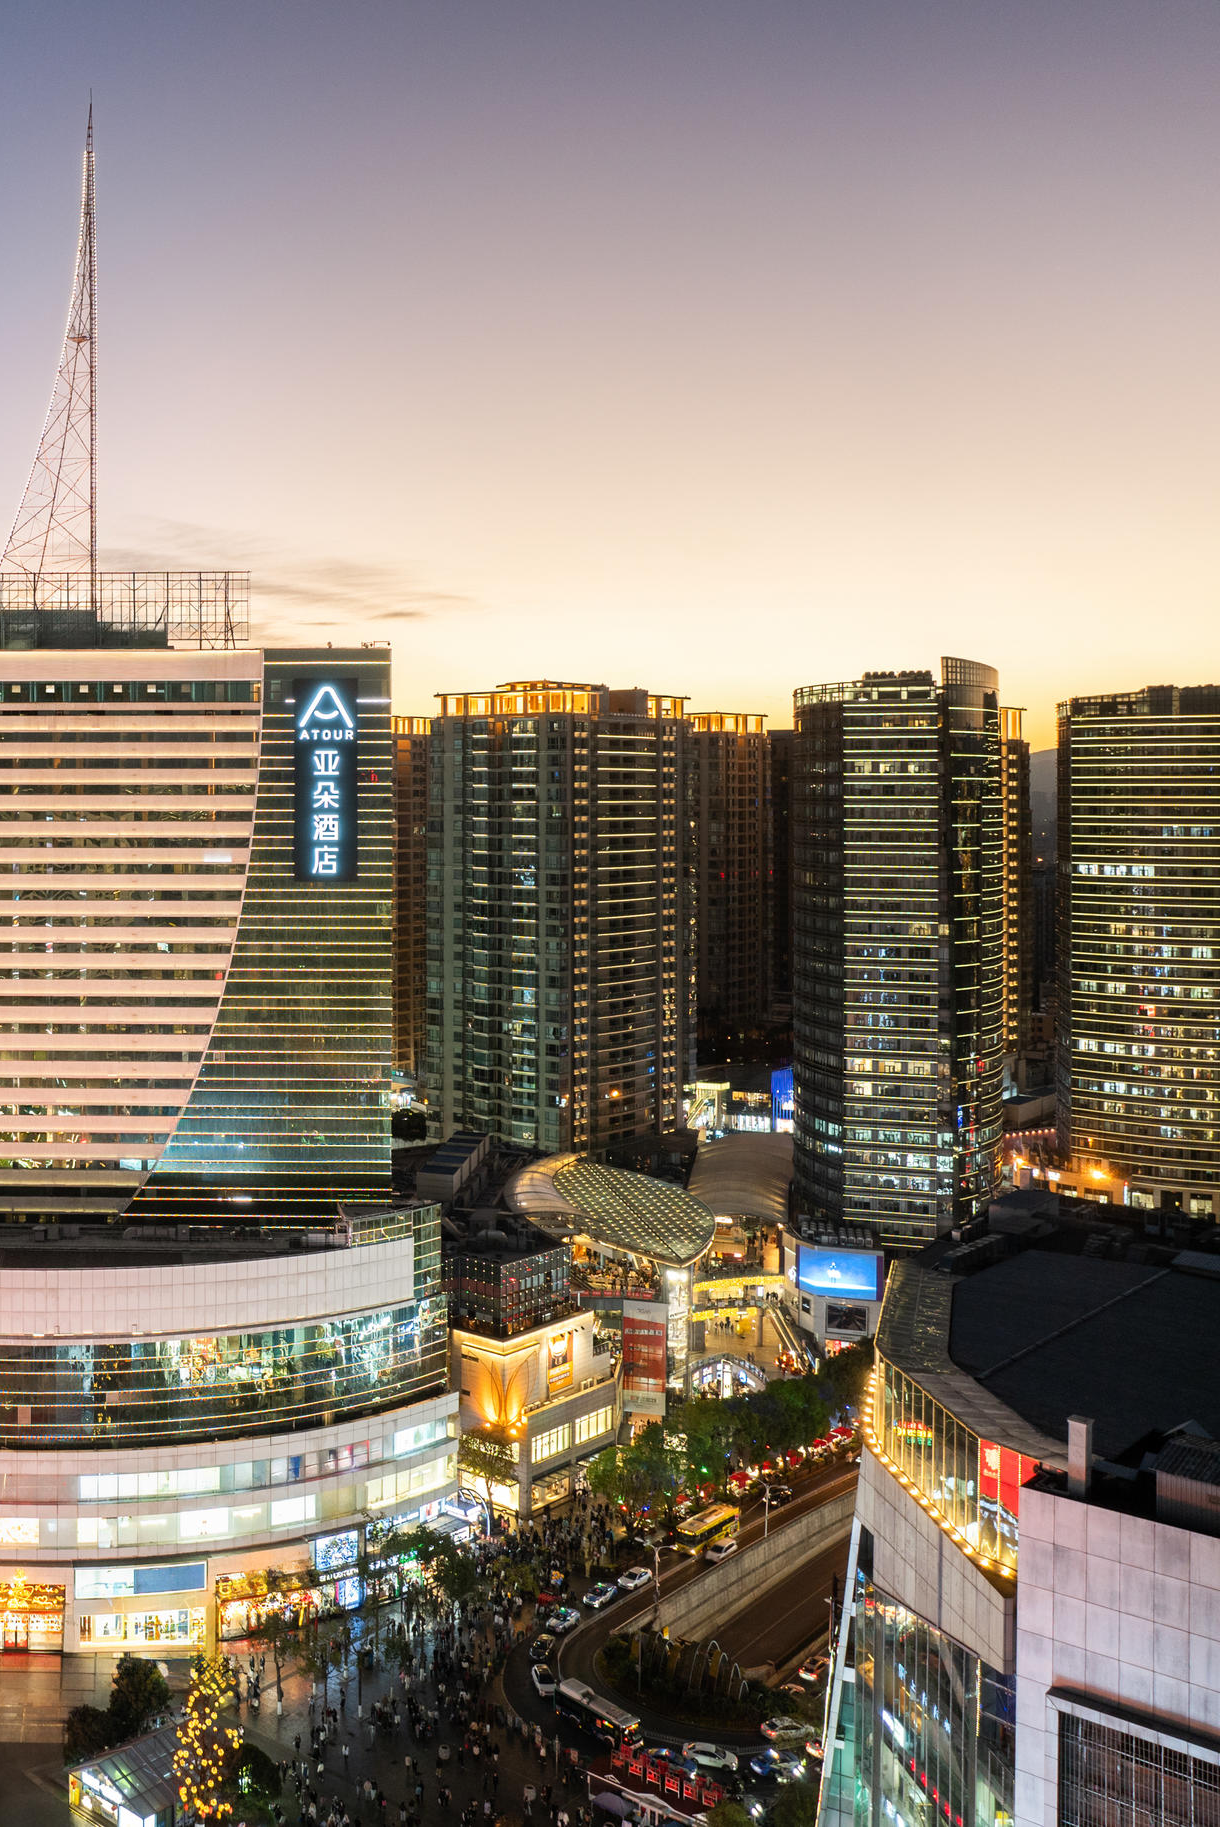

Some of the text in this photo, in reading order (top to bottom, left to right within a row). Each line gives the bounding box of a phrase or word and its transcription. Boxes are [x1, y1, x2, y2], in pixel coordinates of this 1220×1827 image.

[299, 729, 354, 741] ATOUR
[312, 750, 340, 874] 亚朵酒店
